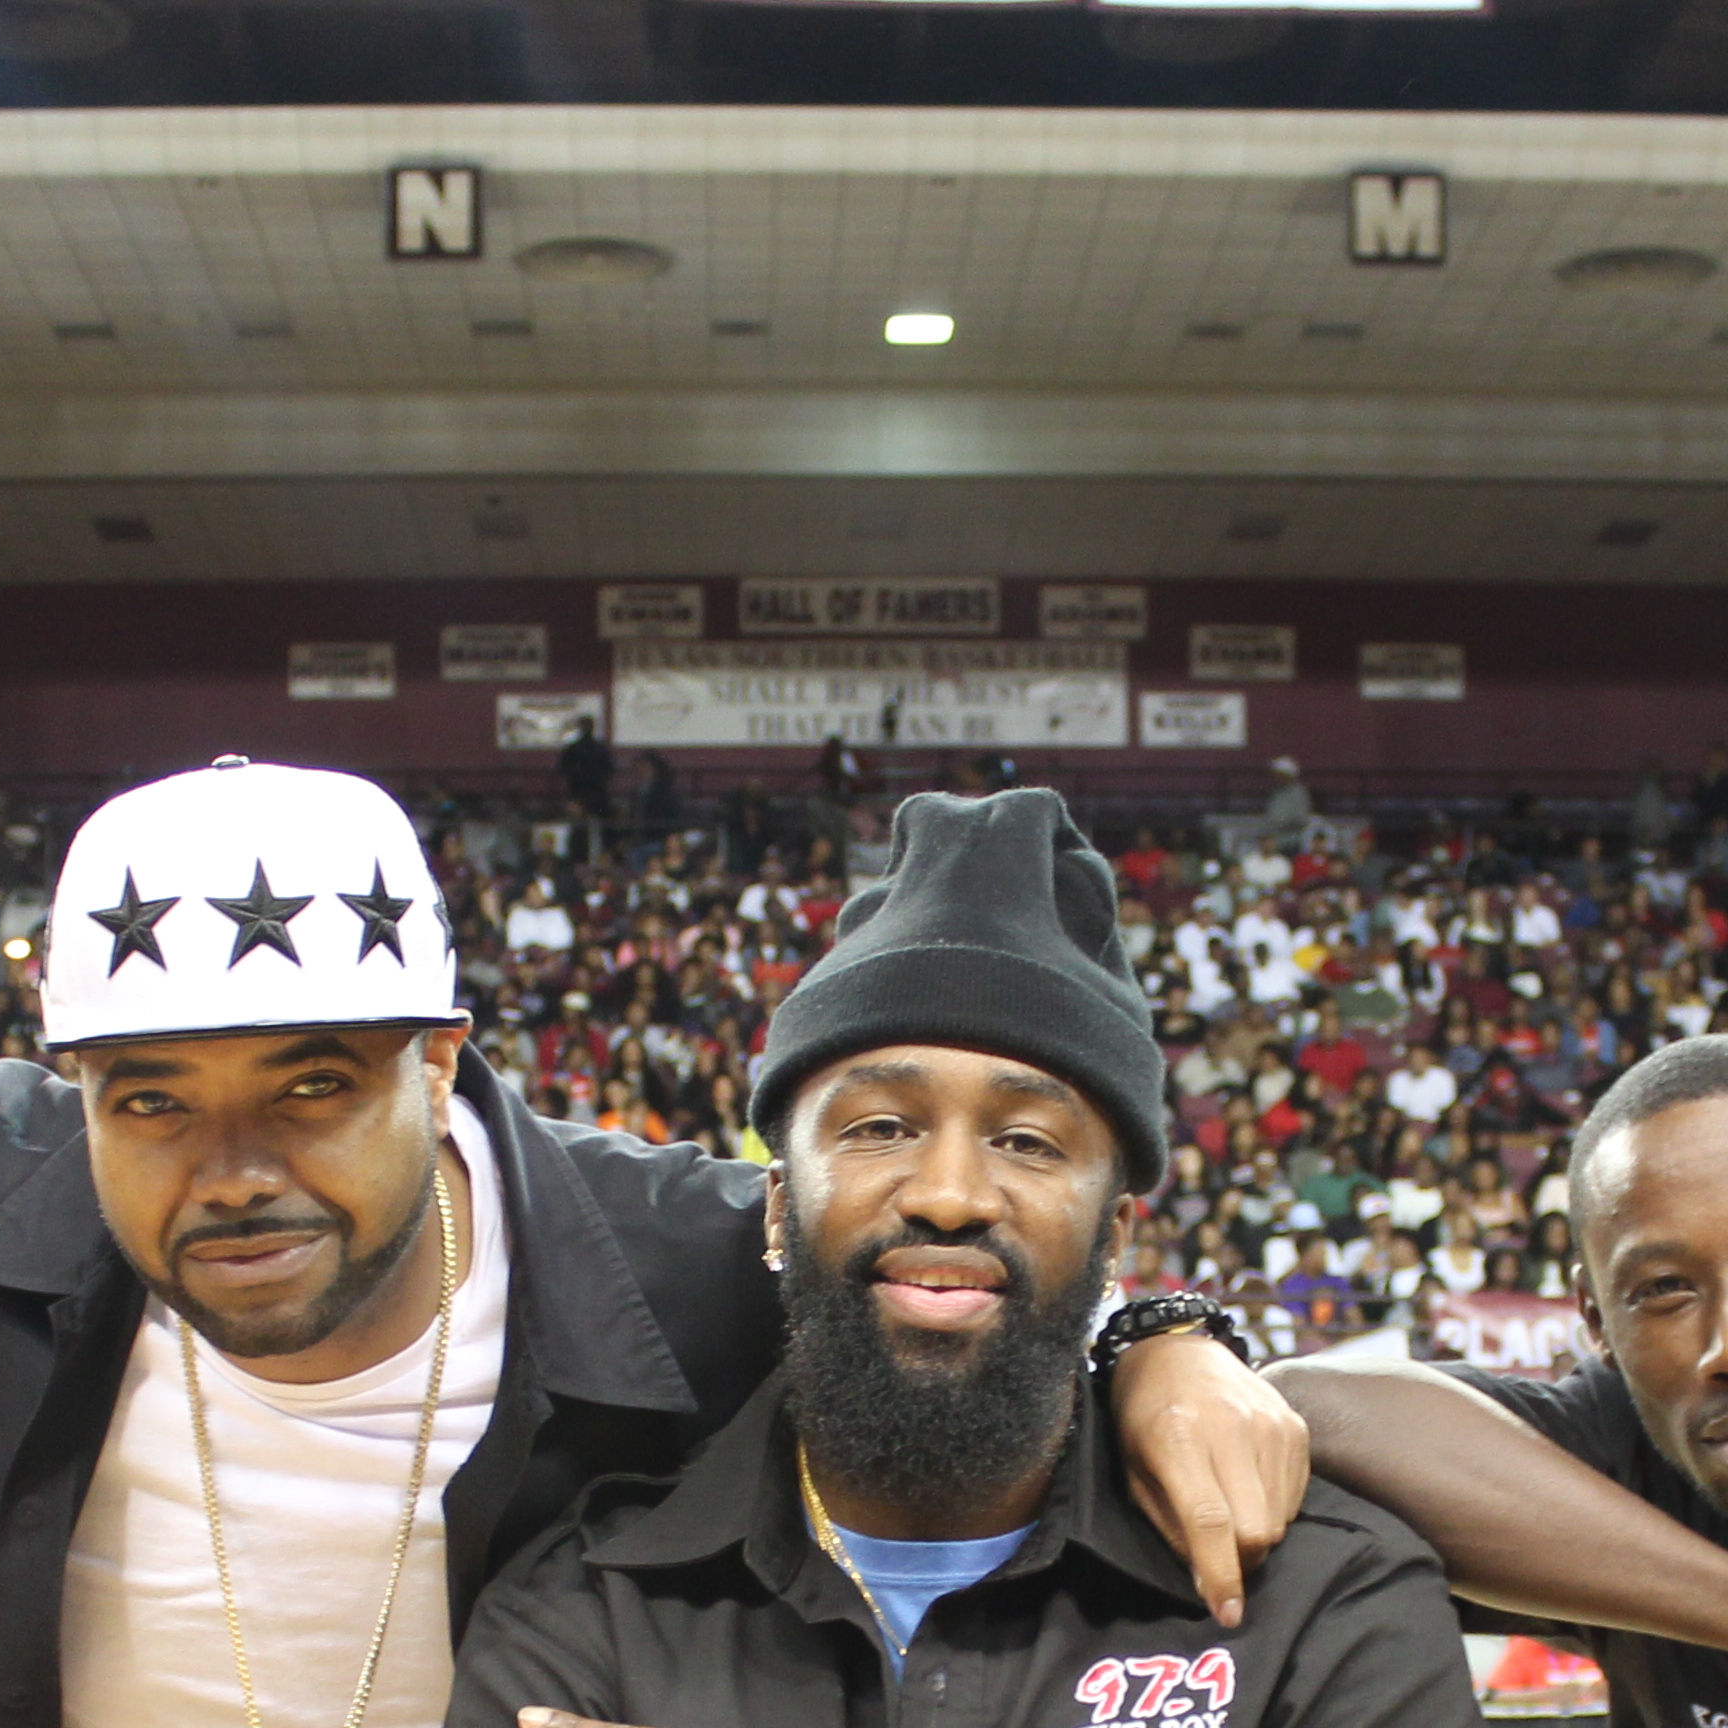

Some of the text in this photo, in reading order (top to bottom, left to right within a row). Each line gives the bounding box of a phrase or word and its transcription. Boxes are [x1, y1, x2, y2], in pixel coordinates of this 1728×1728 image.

[396, 169, 472, 252] N
[1355, 175, 1441, 258] M
[747, 587, 990, 623] HALL OF FAMERS
[1075, 1647, 1236, 1723] 97.9
